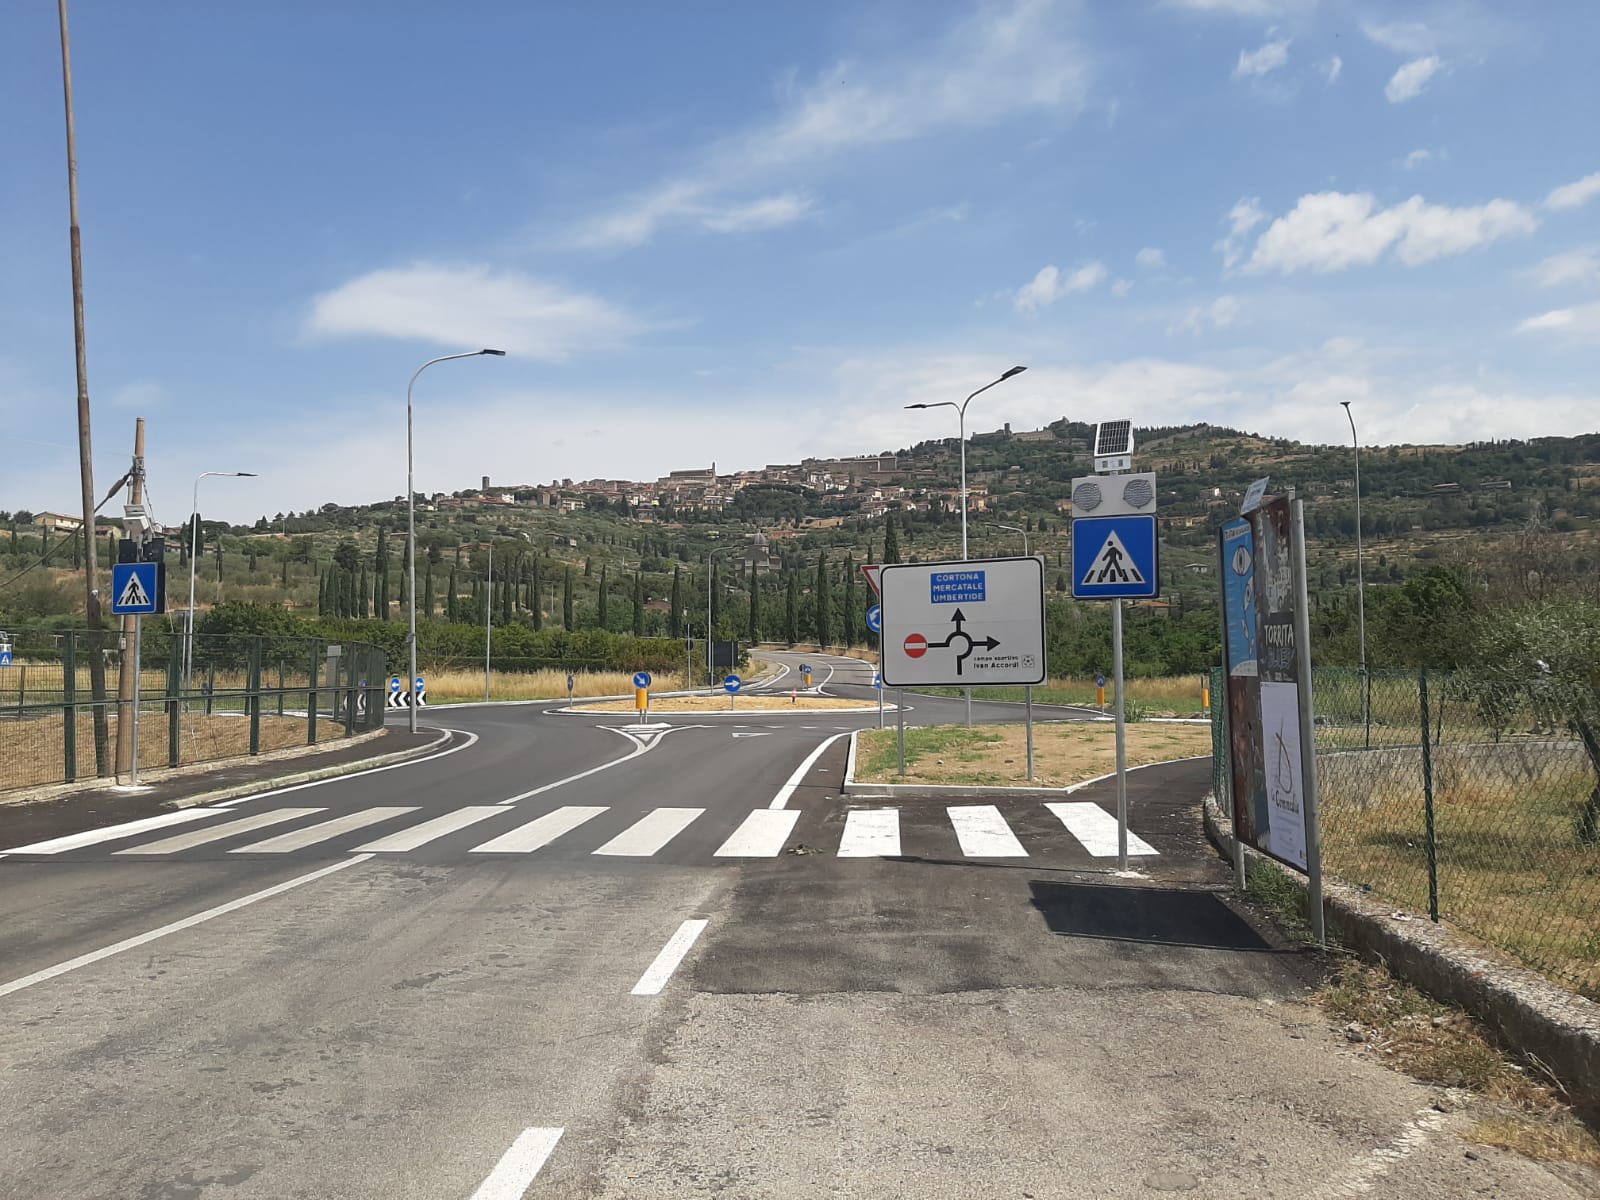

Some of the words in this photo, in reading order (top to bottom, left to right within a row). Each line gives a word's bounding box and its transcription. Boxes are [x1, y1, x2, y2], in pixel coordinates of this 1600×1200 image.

[936, 573, 979, 582] CORTONA
[933, 582, 983, 592] MERCATALE
[933, 592, 983, 602] UMBERTIDE
[1263, 623, 1294, 647] TORRITA
